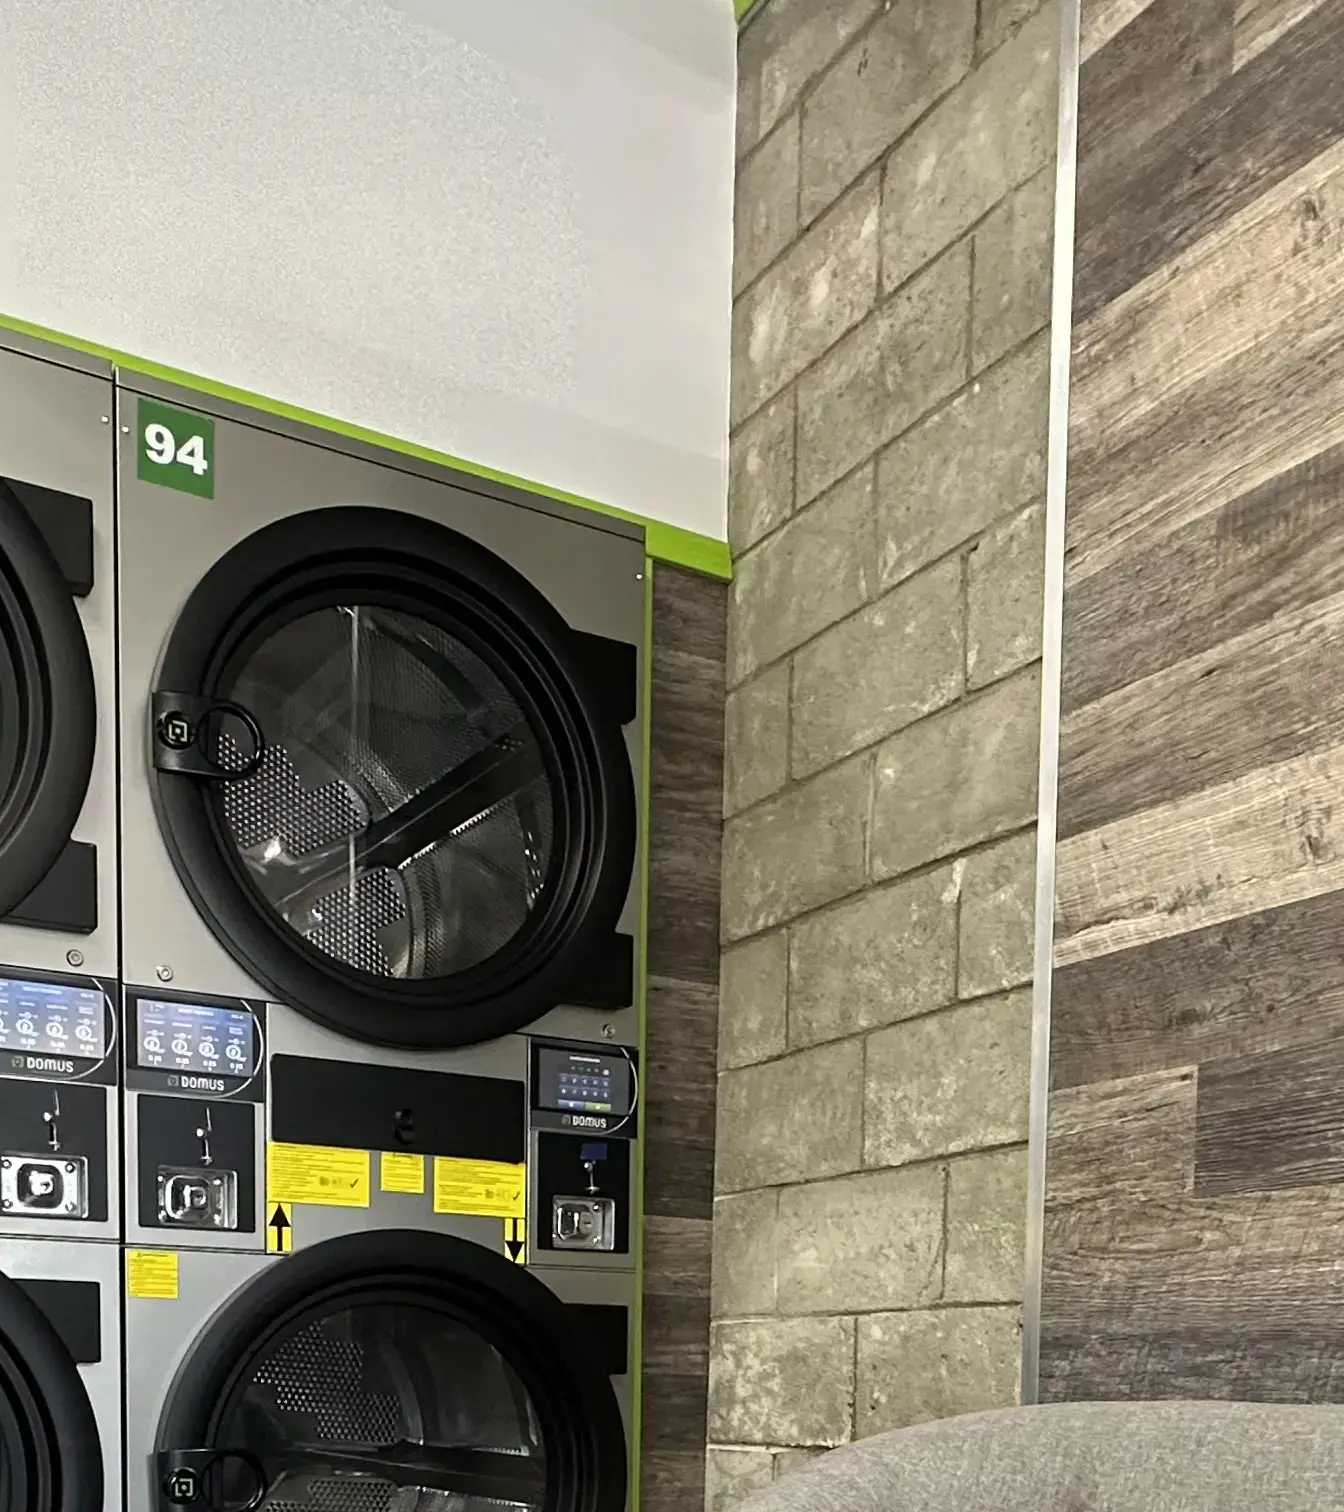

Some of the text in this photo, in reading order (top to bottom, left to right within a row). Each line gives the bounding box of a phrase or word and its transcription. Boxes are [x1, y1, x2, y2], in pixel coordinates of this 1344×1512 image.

[145, 423, 208, 476] 94
[26, 1057, 74, 1073] DOMUS
[181, 1076, 225, 1091] DOMUS
[572, 1115, 607, 1128] DOMUS
